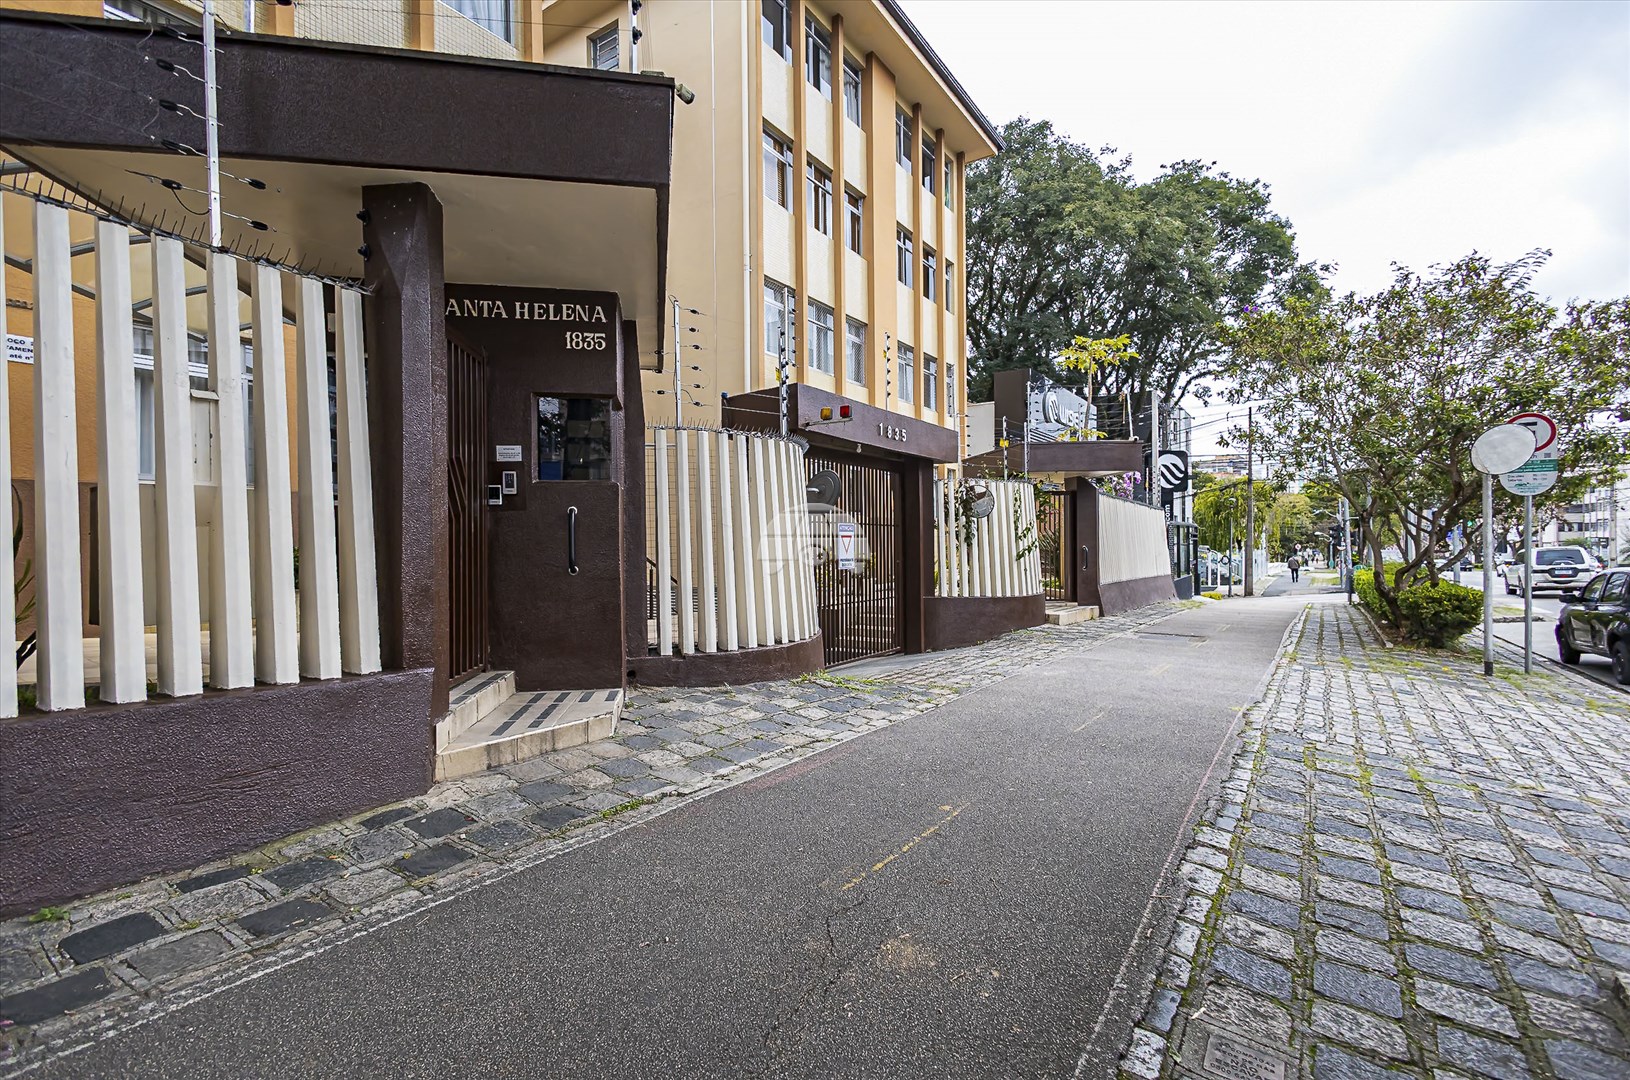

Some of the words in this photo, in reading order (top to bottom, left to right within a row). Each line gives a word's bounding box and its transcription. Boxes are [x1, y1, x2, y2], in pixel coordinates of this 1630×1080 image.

[444, 298, 508, 319] ANTA
[514, 301, 607, 323] HELENA
[565, 331, 607, 351] 1835
[879, 422, 907, 442] 1835
[1210, 1062, 1232, 1075] 0800
[1230, 1058, 1259, 1075] NÃO
